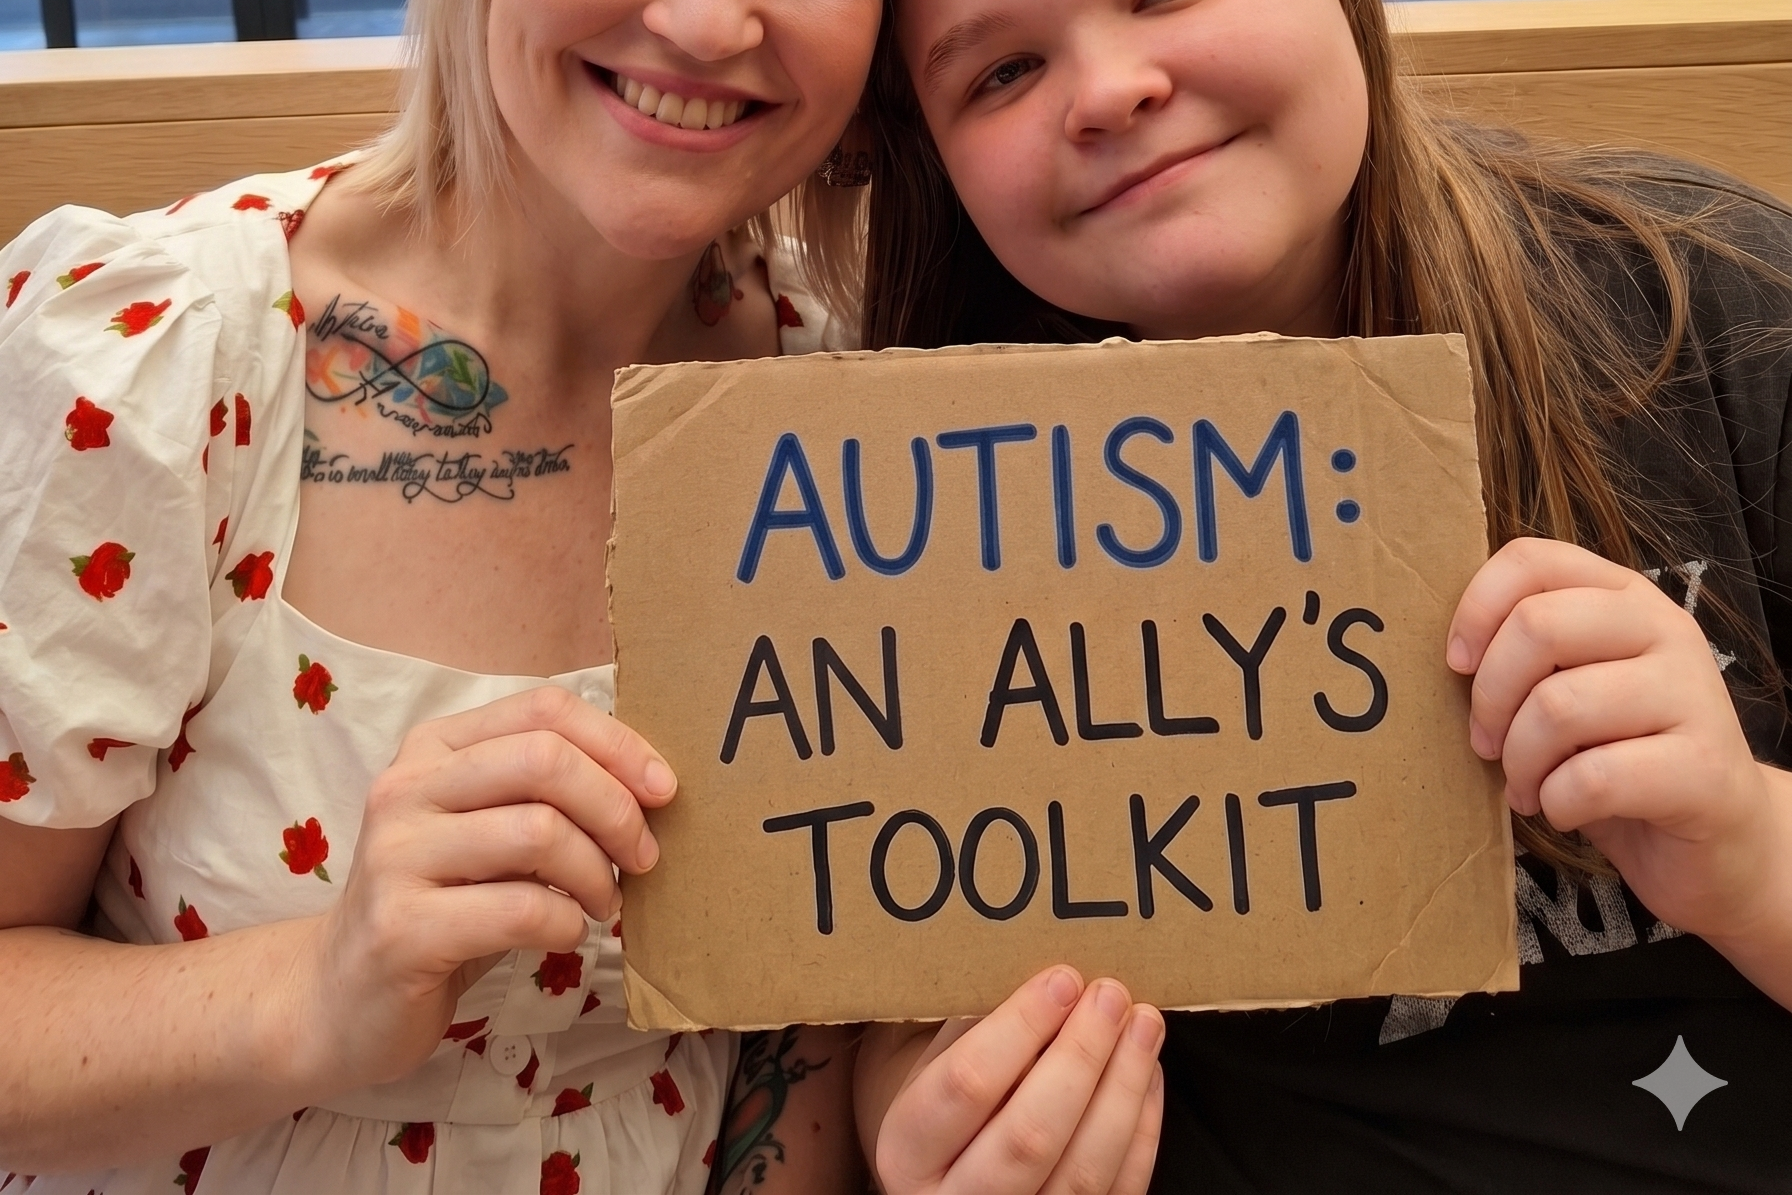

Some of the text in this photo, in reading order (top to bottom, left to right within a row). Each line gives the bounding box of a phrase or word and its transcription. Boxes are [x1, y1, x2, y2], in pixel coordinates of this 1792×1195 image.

[737, 411, 1361, 583] AUTISM:
[719, 590, 1390, 765] AN ALLY'S
[762, 780, 1358, 936] TOOLKIT
